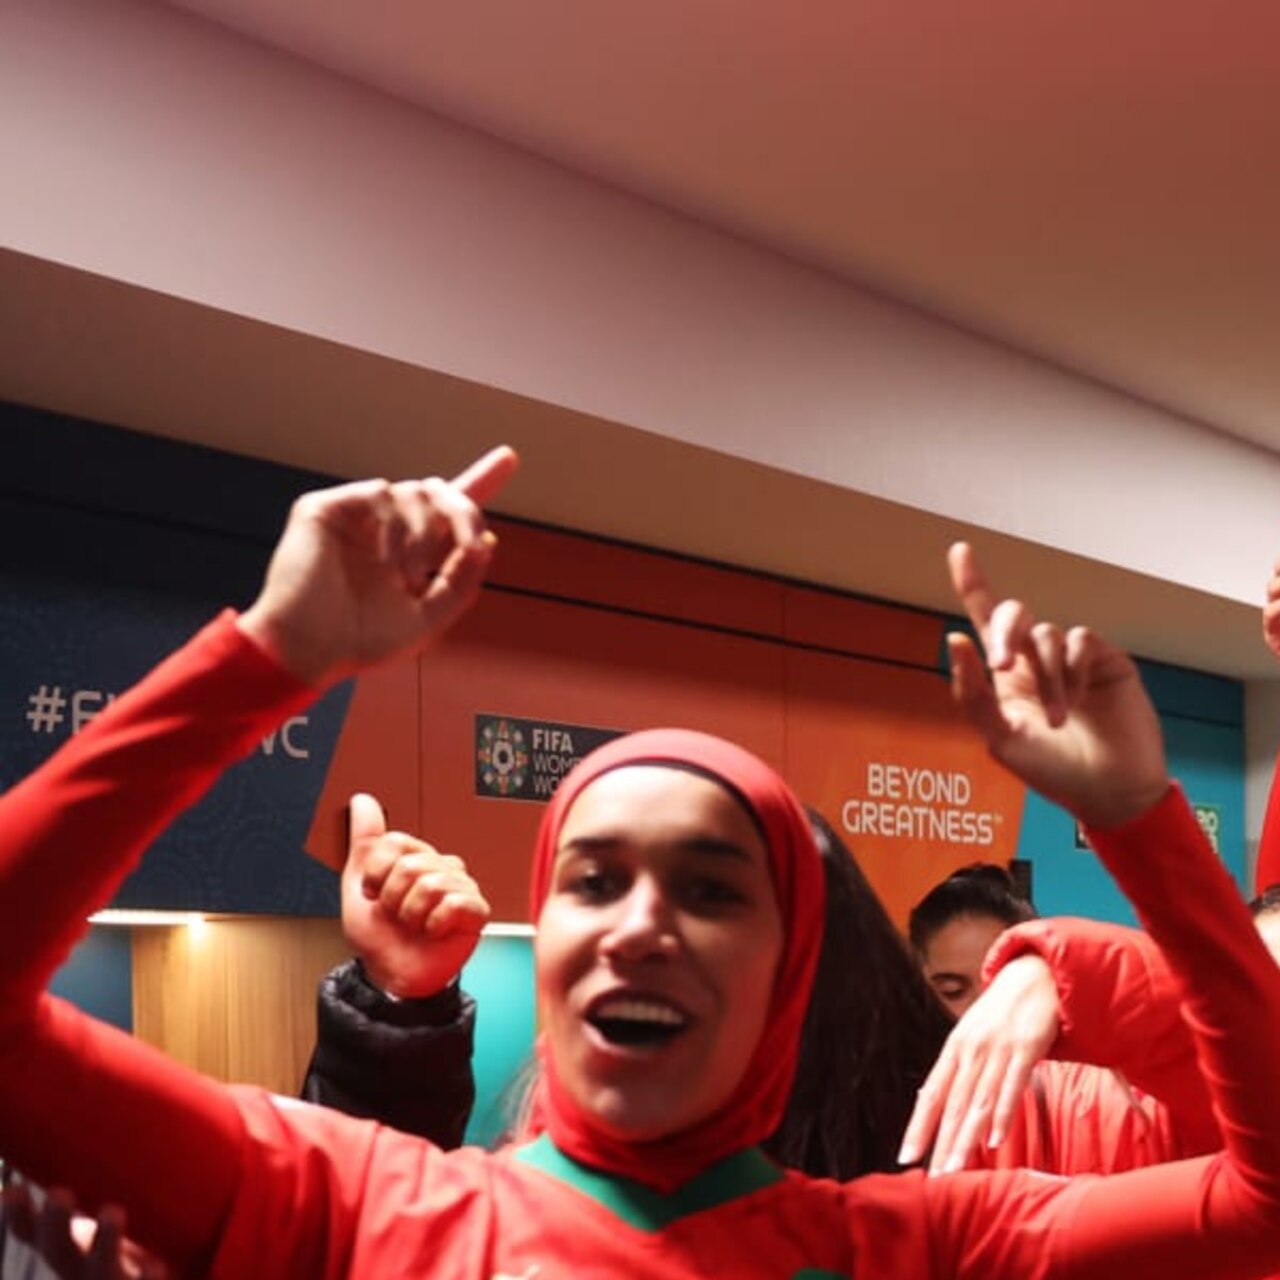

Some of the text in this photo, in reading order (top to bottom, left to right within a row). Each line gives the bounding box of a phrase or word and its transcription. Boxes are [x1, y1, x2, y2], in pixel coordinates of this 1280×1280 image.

[532, 729, 573, 752] FIFA
[867, 763, 971, 805] BEYOND
[842, 800, 993, 845] GREATNESS
